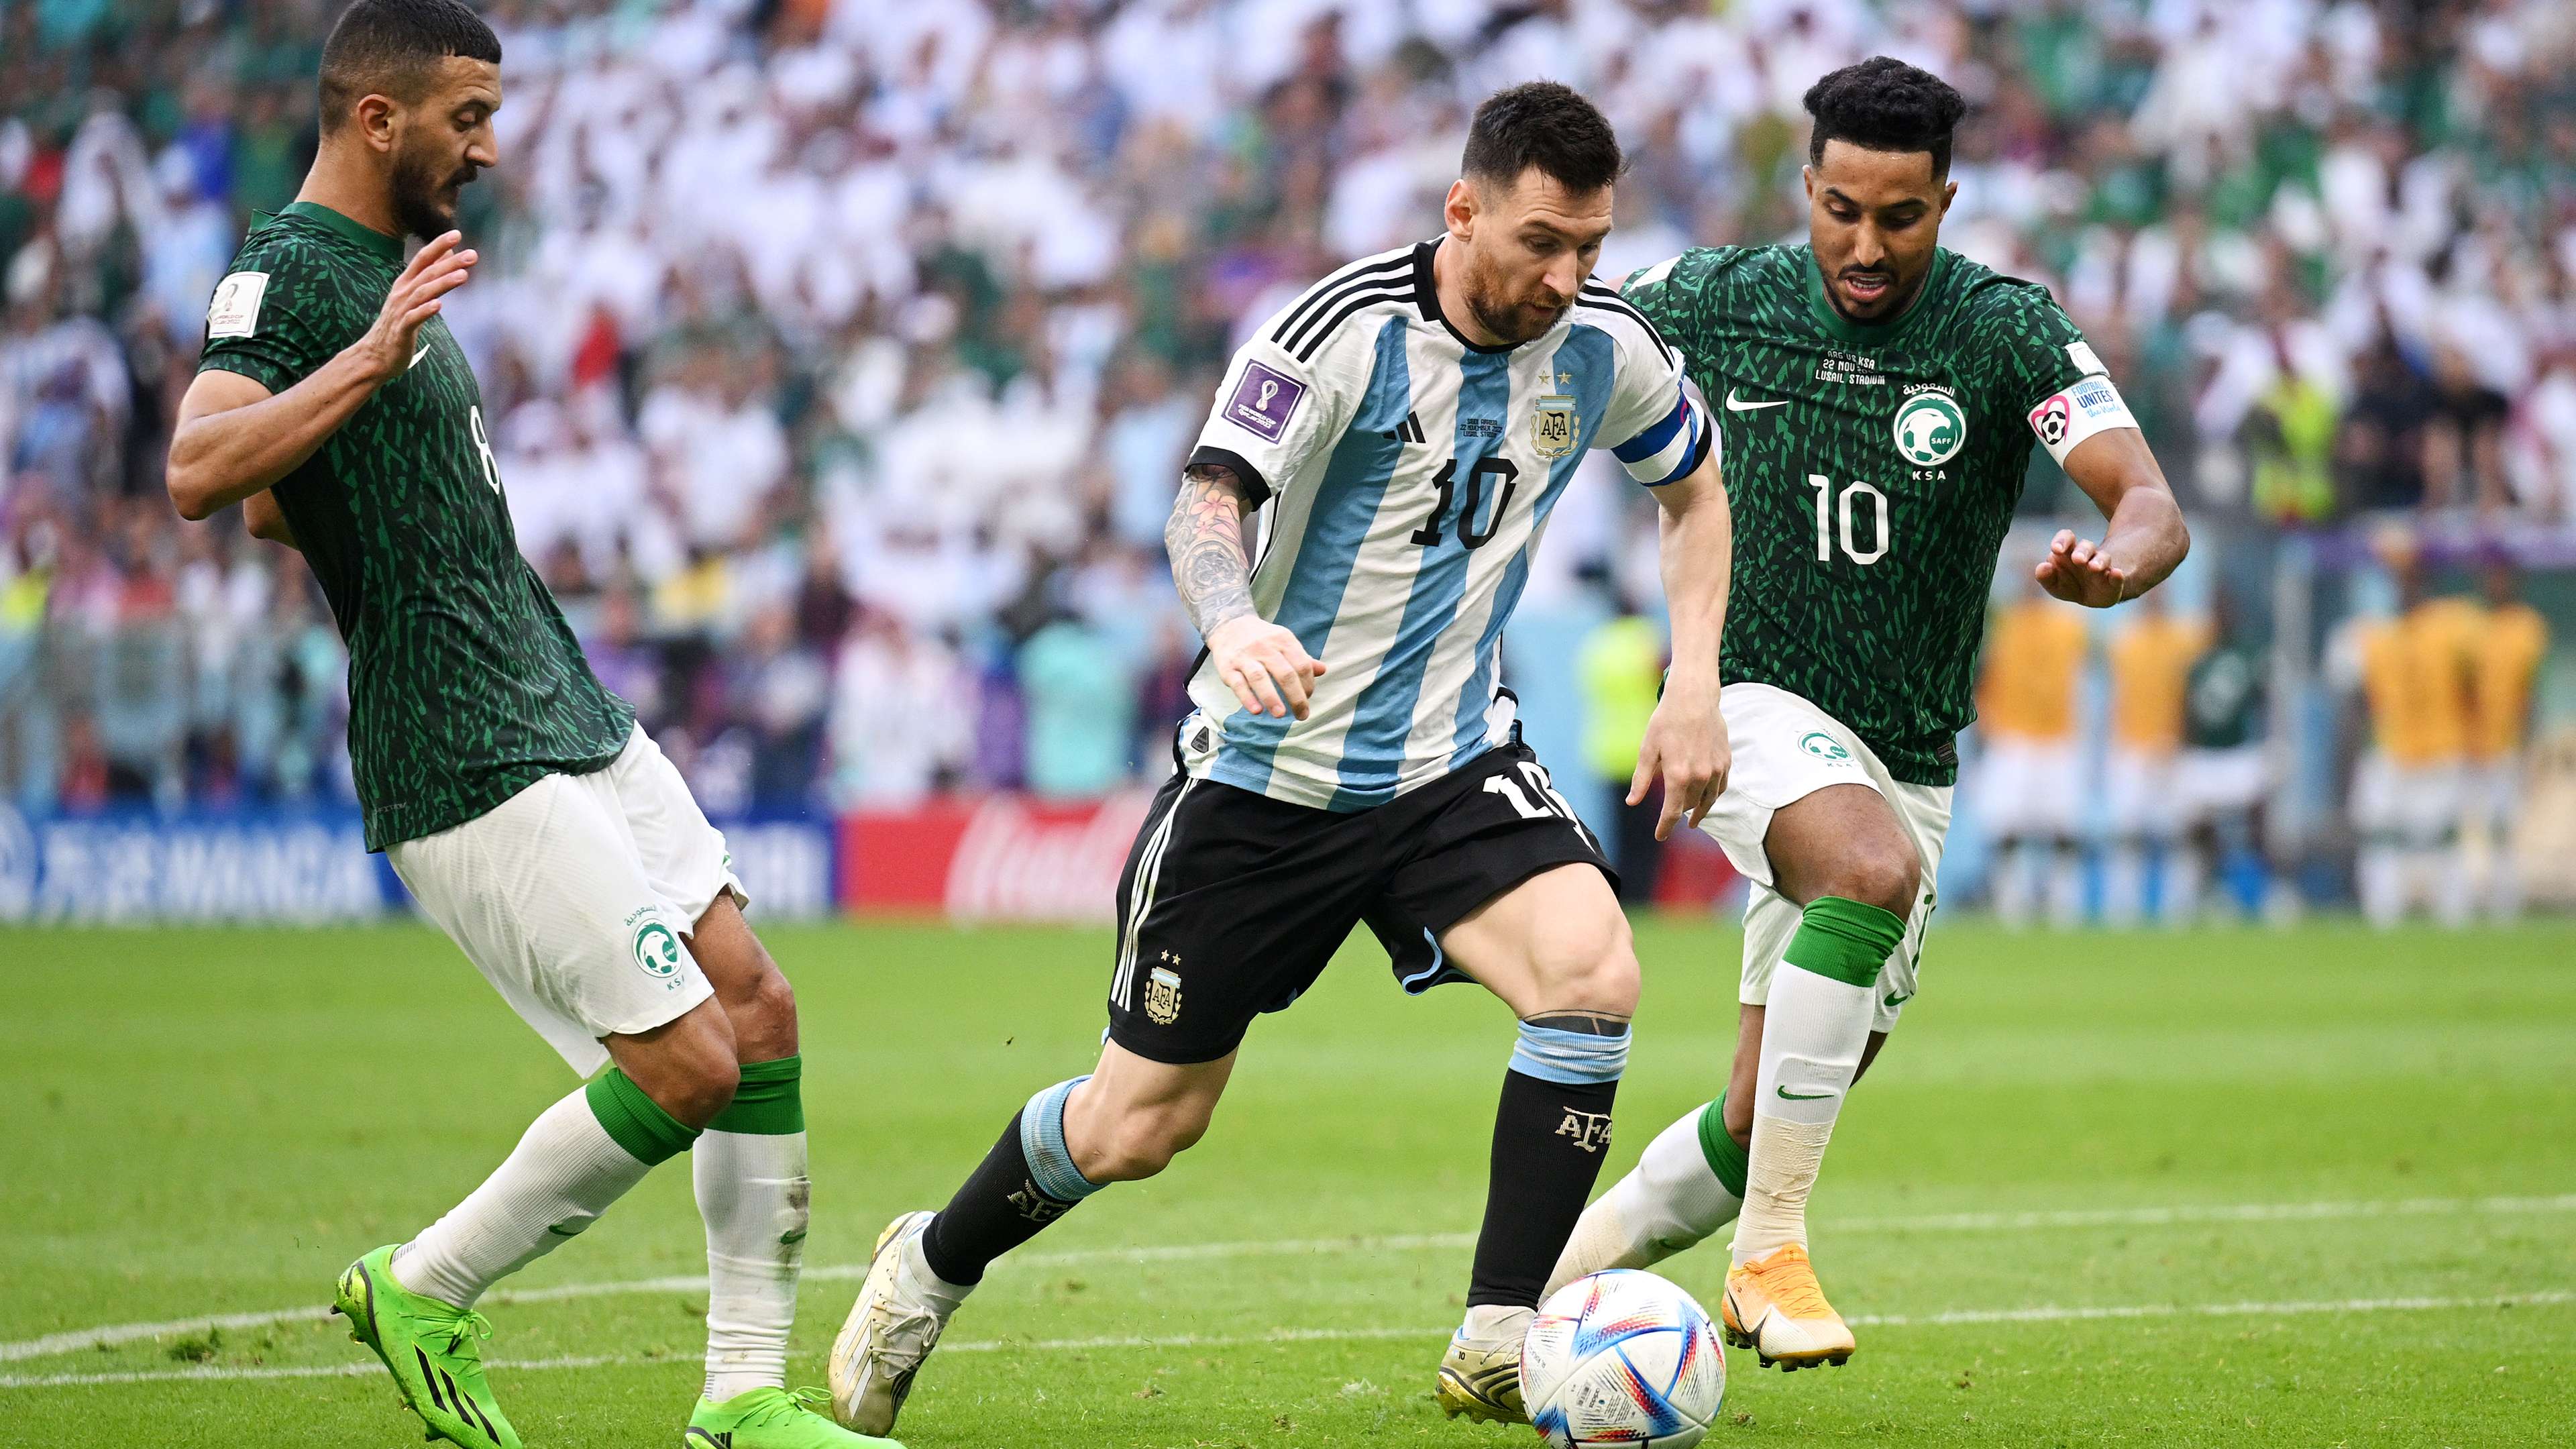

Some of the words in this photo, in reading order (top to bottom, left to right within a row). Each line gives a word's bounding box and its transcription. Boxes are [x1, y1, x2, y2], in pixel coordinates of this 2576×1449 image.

[1823, 358, 1835, 370] 22
[1838, 360, 1856, 372] NOV
[1827, 350, 1843, 359] ARG
[1858, 356, 1875, 370] KSA
[1815, 369, 1845, 384] LUSAIL
[1849, 374, 1886, 385] STADIUM
[1902, 383, 1955, 398] السعودية
[2071, 380, 2107, 397] FOOTBALL
[2076, 390, 2114, 409] UNITES
[2086, 408, 2101, 418] the
[1541, 412, 1567, 441] AFA
[470, 405, 500, 495] 8
[1410, 457, 1519, 549] 10
[1809, 474, 1889, 565] 10
[1152, 981, 1171, 1010] AFA
[1555, 1106, 1612, 1152] AFA
[1458, 1350, 1466, 1360] 10
